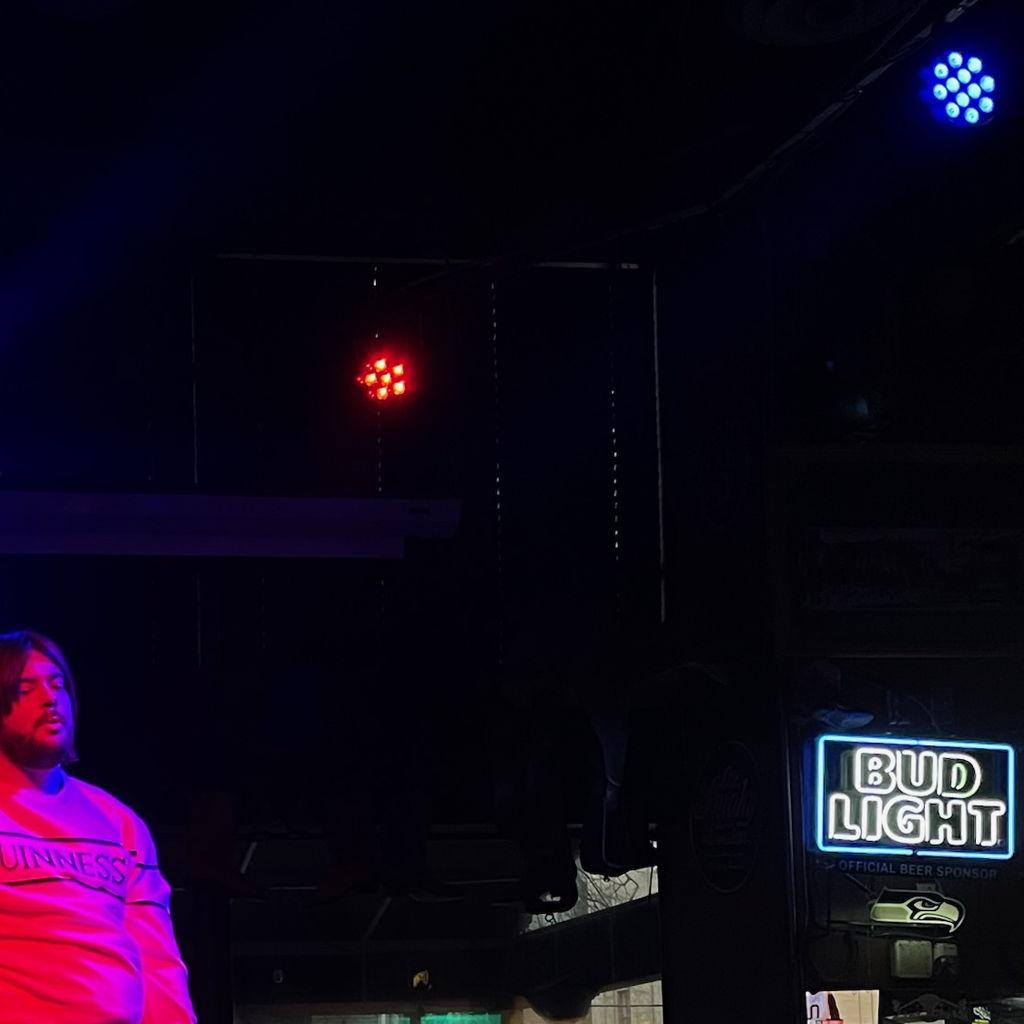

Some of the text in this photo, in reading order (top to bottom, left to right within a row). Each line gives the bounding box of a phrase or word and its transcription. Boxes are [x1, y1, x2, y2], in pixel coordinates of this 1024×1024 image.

[854, 746, 982, 798] BUD
[828, 793, 1006, 847] LIGHT
[838, 859, 999, 880] OFFICIAL BEER SPONSOR
